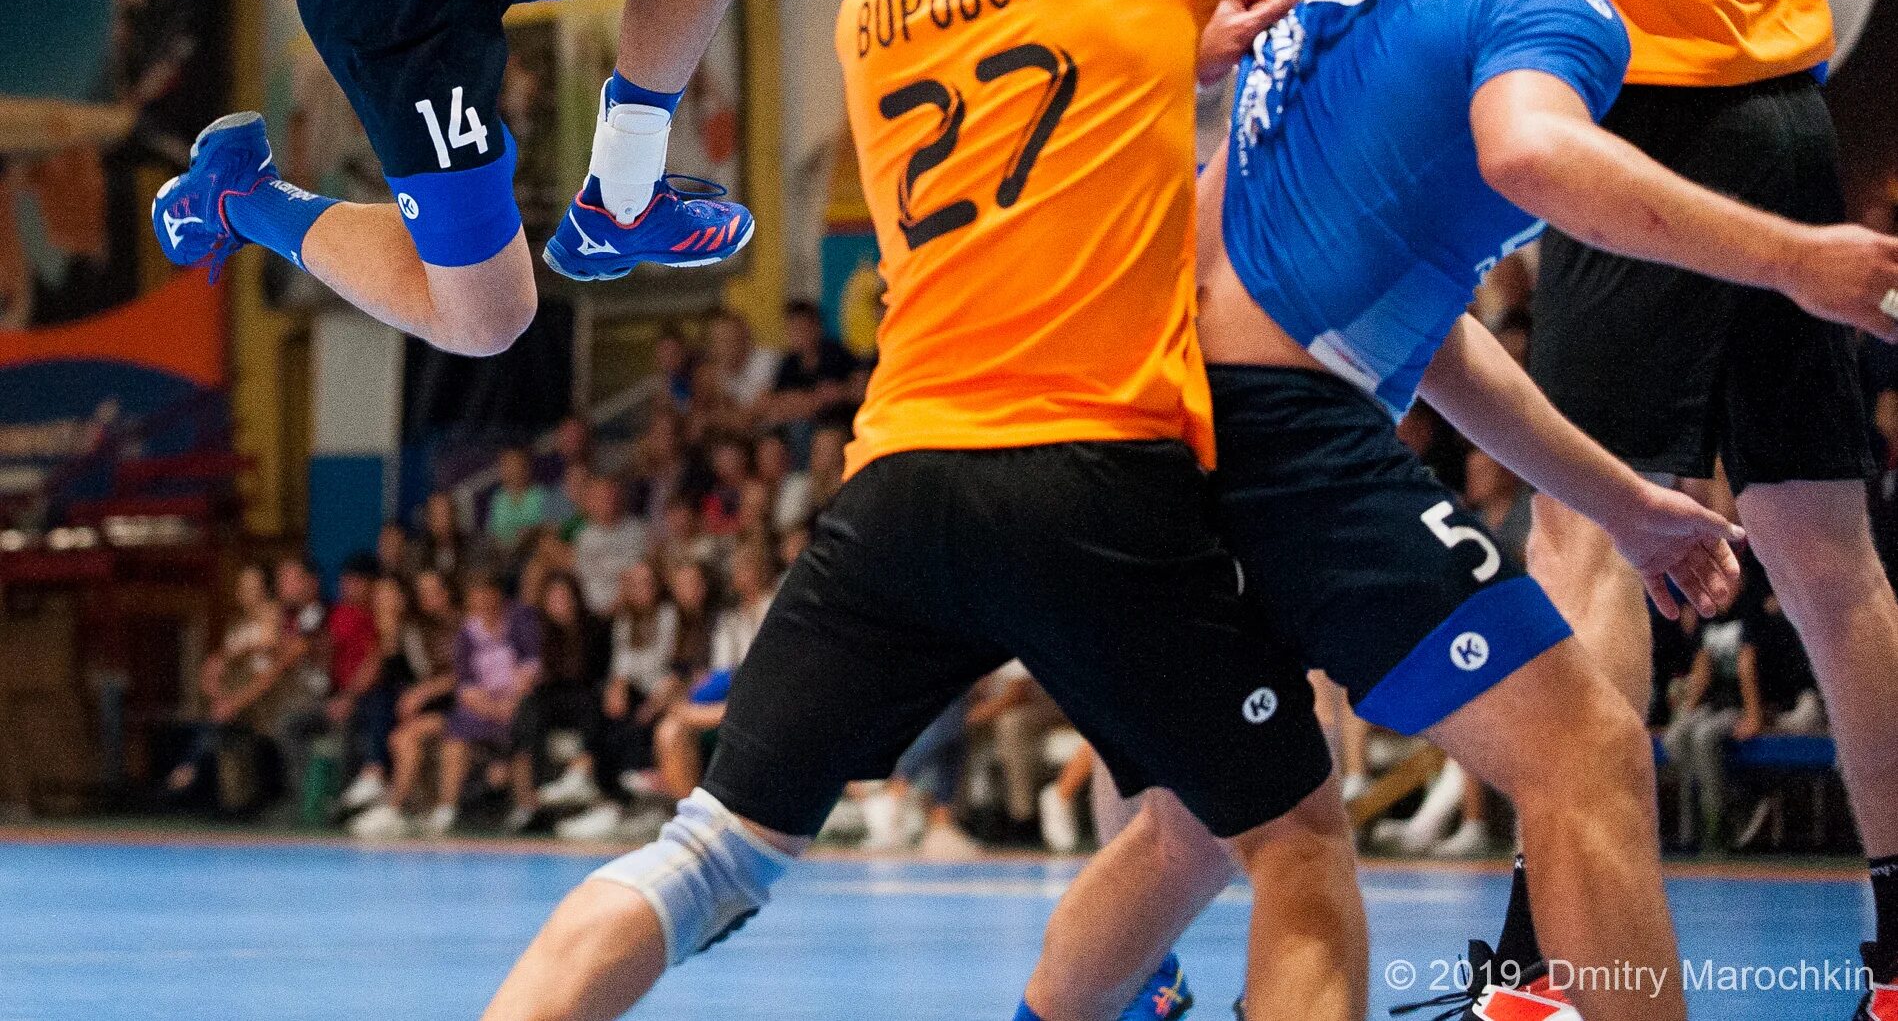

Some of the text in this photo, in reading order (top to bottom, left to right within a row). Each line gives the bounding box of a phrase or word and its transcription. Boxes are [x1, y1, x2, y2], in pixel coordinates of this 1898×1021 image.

[415, 86, 488, 169] 14
[879, 42, 1079, 251] 27
[1420, 500, 1501, 583] 5
